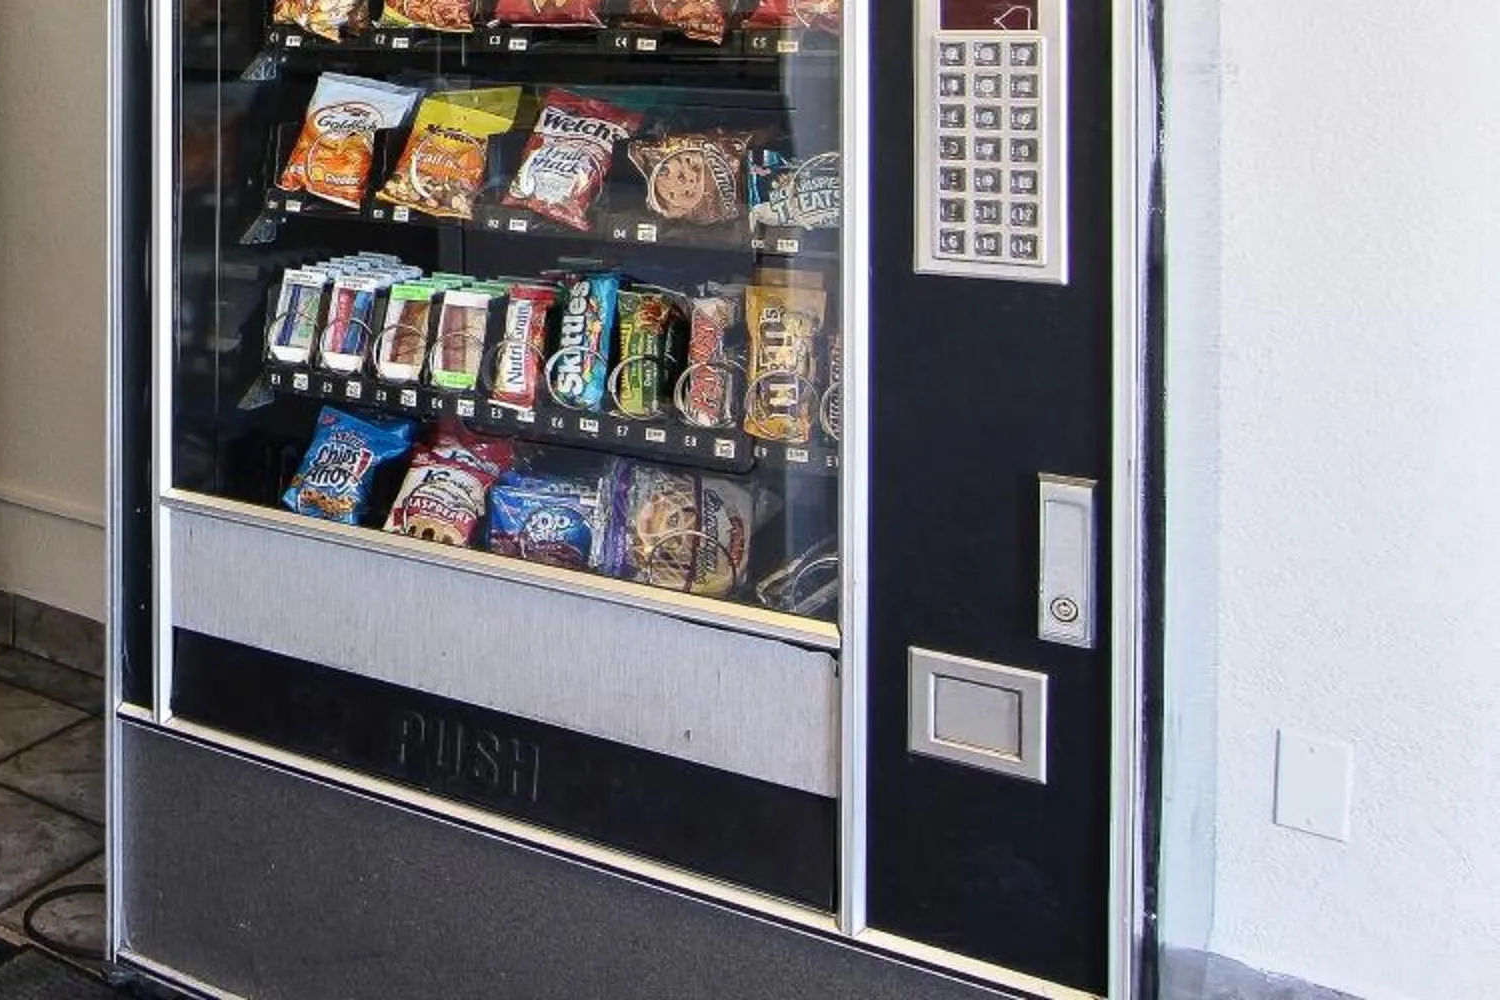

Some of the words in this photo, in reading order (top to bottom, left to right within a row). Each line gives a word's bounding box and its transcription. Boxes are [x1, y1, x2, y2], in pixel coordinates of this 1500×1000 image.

[557, 281, 591, 397] Skittles
[271, 374, 281, 385] E1
[506, 344, 524, 385] Nutri
[617, 425, 629, 437] E7
[315, 441, 361, 467] Chips
[399, 710, 541, 802] PUSH
